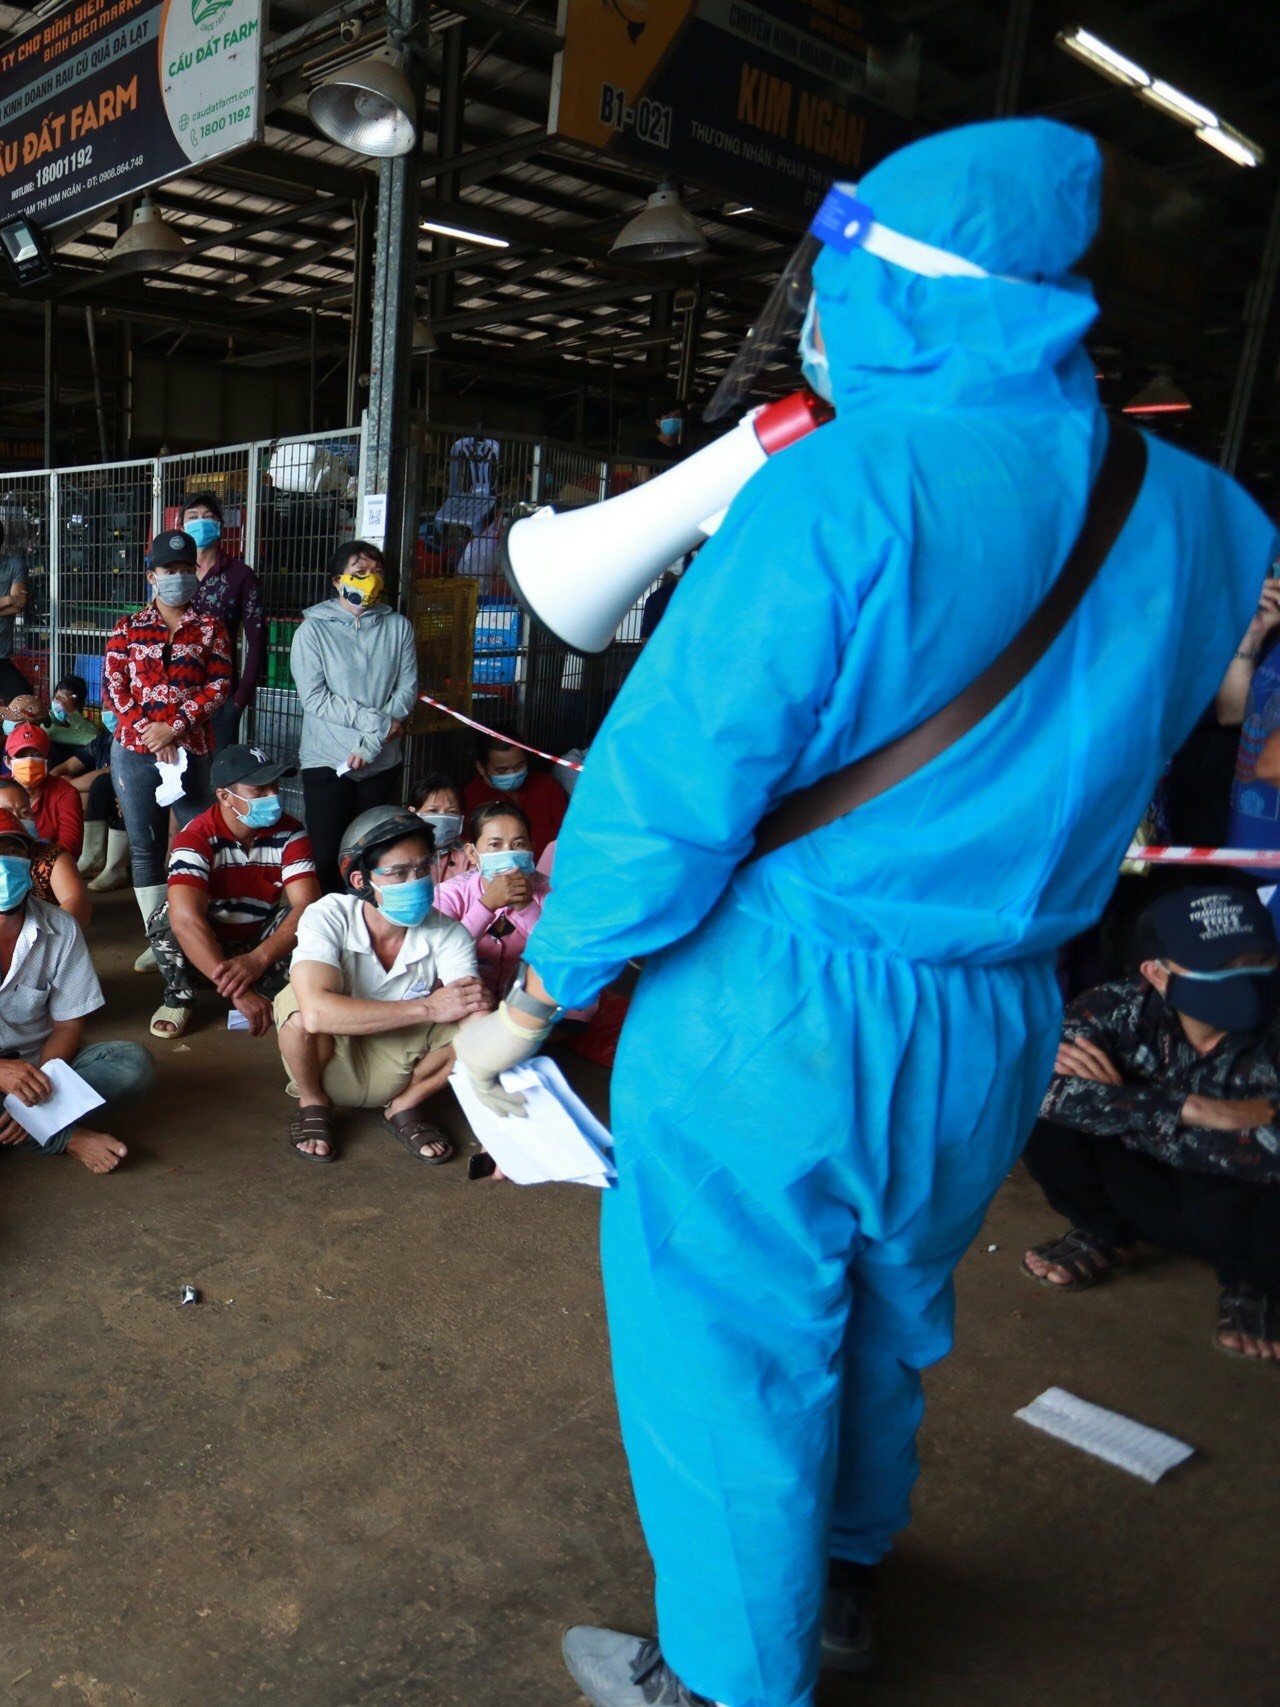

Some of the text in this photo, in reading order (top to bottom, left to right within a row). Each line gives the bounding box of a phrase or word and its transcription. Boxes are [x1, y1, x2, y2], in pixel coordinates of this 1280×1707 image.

[1, 51, 15, 71] TY
[44, 36, 69, 63] BINH
[71, 18, 97, 45] DIEN
[168, 18, 258, 77] CẦU ĐẤT FARM
[3, 98, 22, 120] KINH
[24, 79, 53, 107] DOANH
[55, 67, 74, 88] RAU
[129, 20, 149, 45] LẠT
[22, 111, 66, 165] ĐẤT
[70, 74, 138, 141] FARM
[200, 105, 251, 138] 1800 1192
[737, 62, 793, 139] KIM
[690, 120, 741, 156] THƯƠNG
[11, 144, 93, 200] HOTLINE: 18001192
[48, 192, 61, 206] KIM
